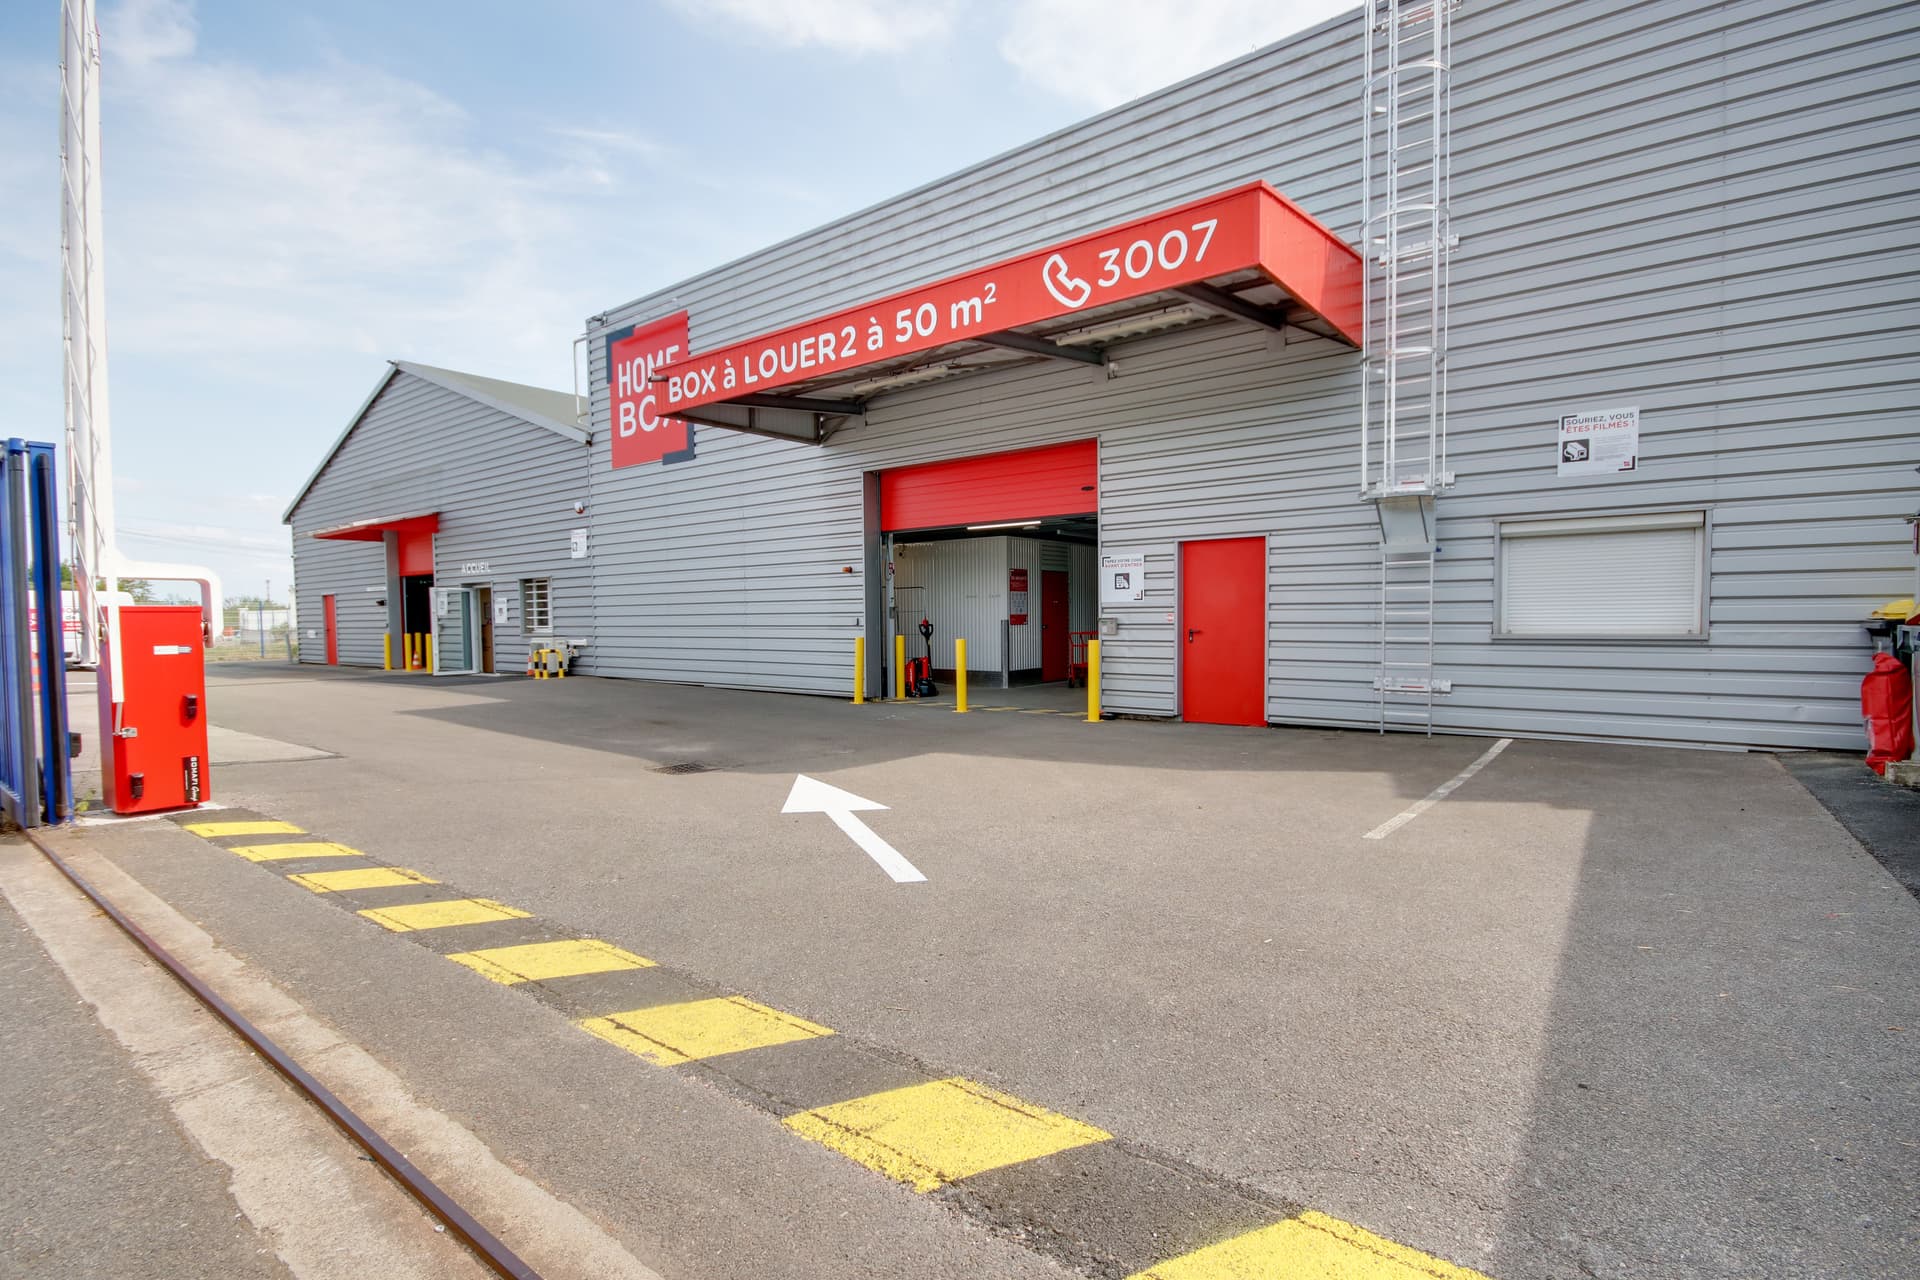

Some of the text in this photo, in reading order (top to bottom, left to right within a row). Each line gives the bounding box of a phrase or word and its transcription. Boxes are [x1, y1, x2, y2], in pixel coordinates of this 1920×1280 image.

[1098, 218, 1218, 287] 3007
[669, 366, 716, 403] BOX
[723, 358, 736, 389] à
[744, 332, 836, 384] LOUER
[840, 326, 857, 358] 2
[867, 316, 884, 351] à
[895, 302, 938, 343] 50
[1610, 412, 1634, 420] VOUS
[1566, 424, 1590, 434] ÊTES
[1593, 420, 1629, 430] FILMÉS
[461, 562, 491, 574] ACCUEIL
